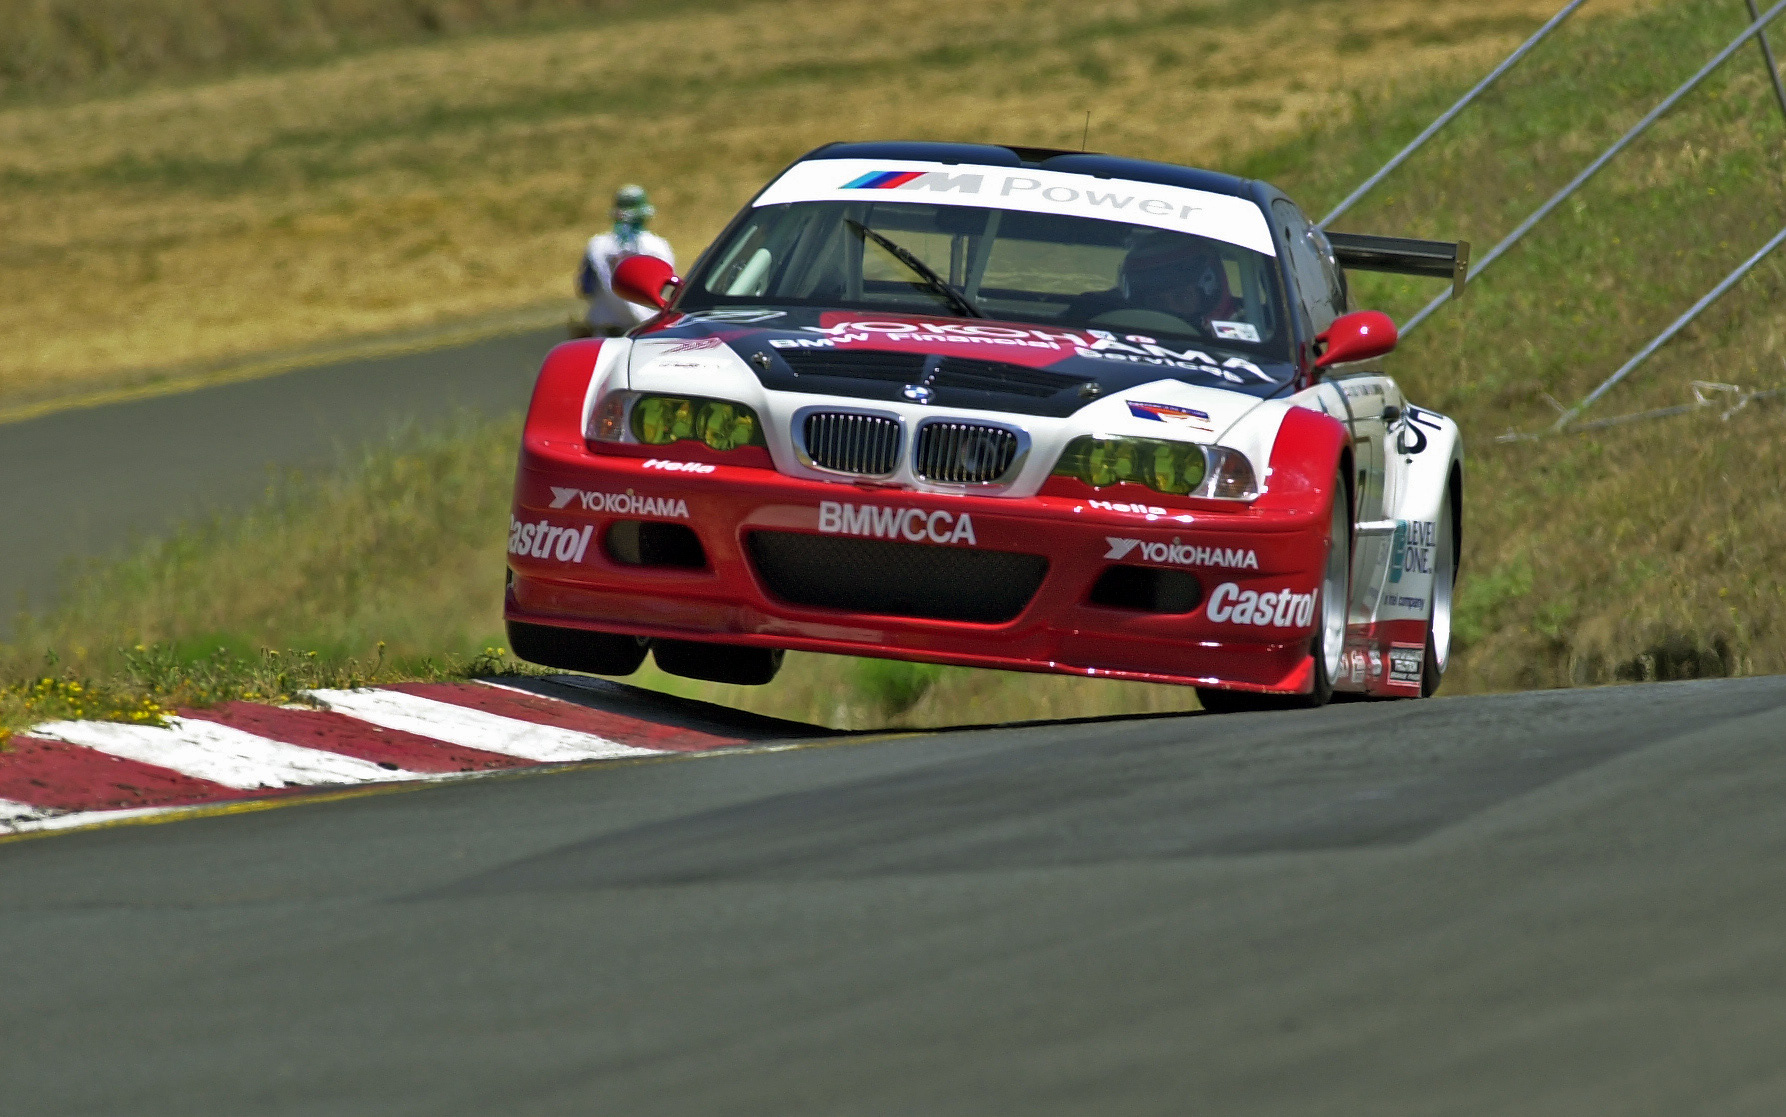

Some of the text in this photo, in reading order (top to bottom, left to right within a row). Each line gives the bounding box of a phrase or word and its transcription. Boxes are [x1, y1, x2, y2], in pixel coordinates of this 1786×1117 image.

[1000, 176, 1202, 220] Power
[768, 332, 870, 349] BMW
[886, 333, 1062, 351] Financial
[642, 458, 717, 474] Hella
[580, 490, 690, 518] YOKOHAMA
[1088, 500, 1168, 515] Hella
[818, 500, 977, 546] BMWCCA
[1406, 520, 1436, 547] LEVEL
[1140, 541, 1259, 570] YOKOHAMA
[1206, 582, 1319, 628] Castrol
